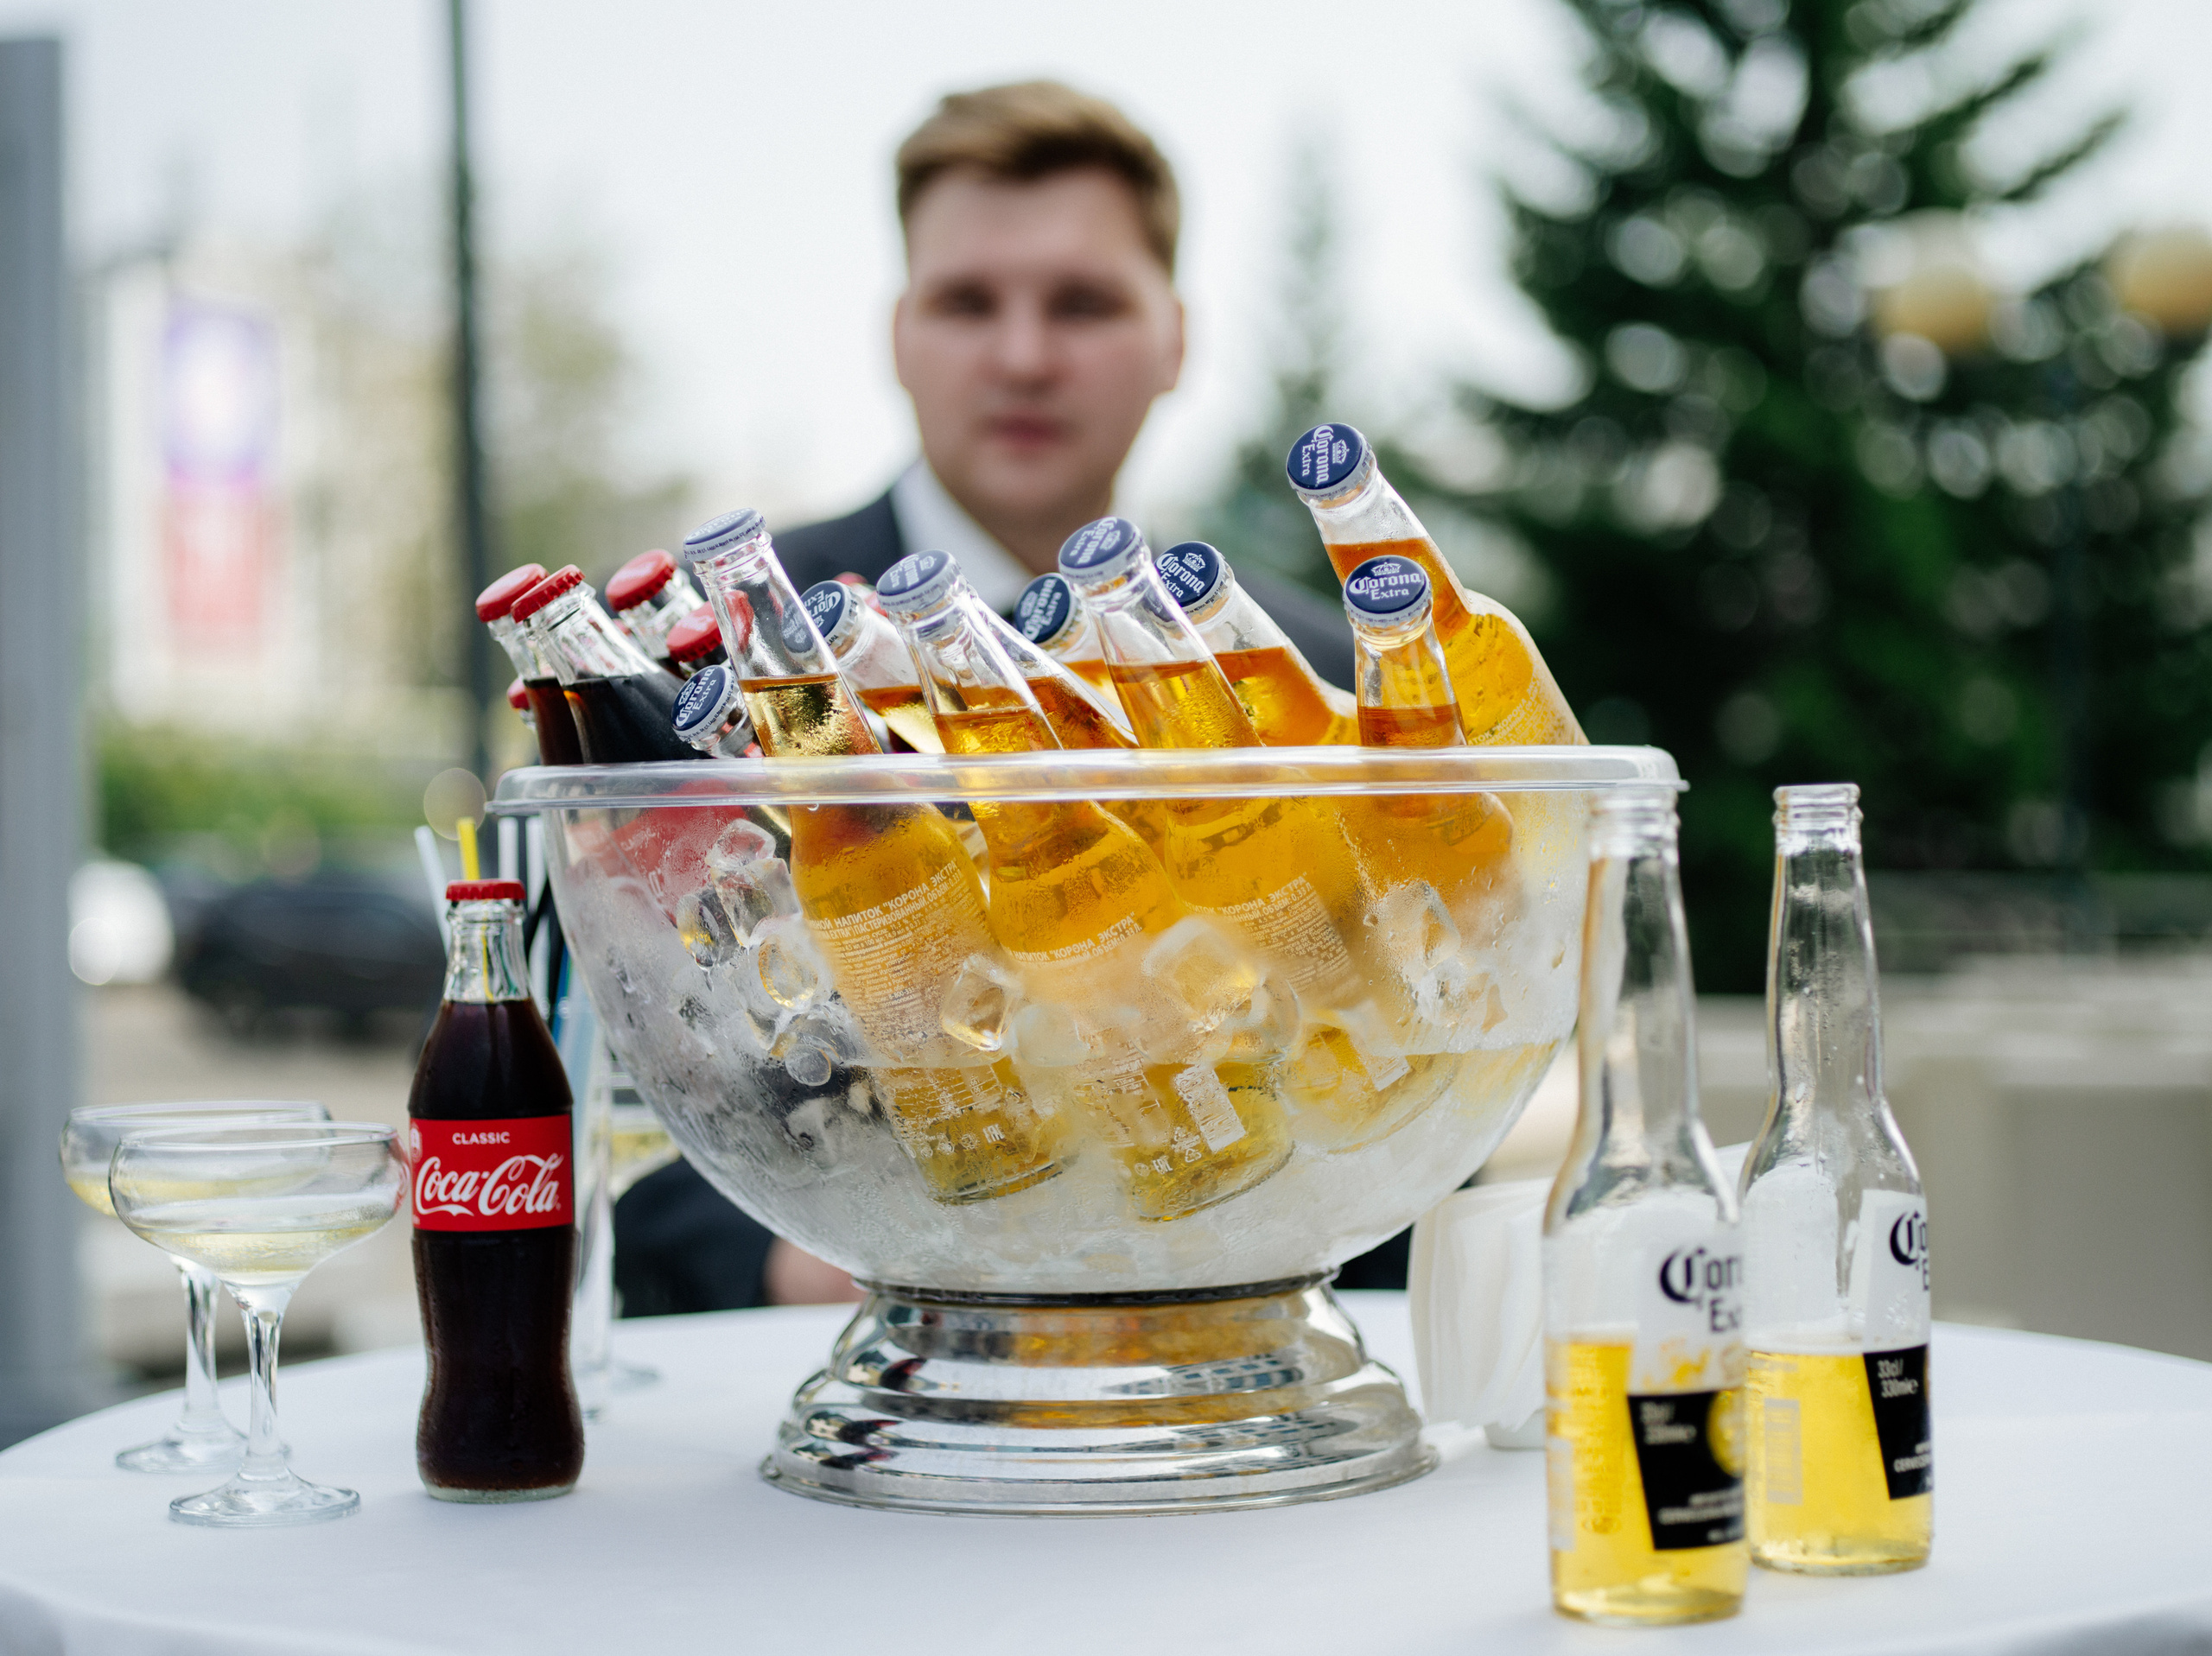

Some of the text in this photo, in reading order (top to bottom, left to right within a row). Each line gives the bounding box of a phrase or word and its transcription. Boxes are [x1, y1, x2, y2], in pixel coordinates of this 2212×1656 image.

[1301, 442, 1315, 477] Extra
[1311, 425, 1333, 484] Corona
[1070, 530, 1095, 556] Extra
[1077, 517, 1117, 565] Corona
[890, 566, 902, 587] Extra
[899, 554, 919, 587] Corona
[1156, 553, 1205, 593] Corona
[1161, 572, 1184, 598] Extra
[1349, 573, 1421, 594] Corona
[808, 591, 842, 617] Cor
[1022, 579, 1057, 641] Corona
[1039, 592, 1062, 625] Extra
[1370, 588, 1409, 600] Extra
[676, 669, 715, 726] Corona
[692, 679, 717, 710] Extra
[834, 904, 883, 929] НАПИТОК
[883, 882, 930, 911] "КОРОНА
[931, 858, 958, 887] ЭКСТРА"
[1217, 898, 1266, 916] "КОРОНА
[1268, 872, 1307, 903] ЭКСТРА"
[1262, 896, 1293, 916] ОБЪЕМ:
[1291, 888, 1307, 903] 0,33
[1013, 950, 1050, 962] НАПИТОК
[1049, 938, 1096, 960] "КОРОНА
[1097, 911, 1135, 943] ЭКСТРА"
[1299, 934, 1309, 943] del
[452, 1132, 511, 1145] CLASSIC
[415, 1152, 564, 1217] Coca-Cola
[1889, 1209, 1928, 1271] Co
[1657, 1244, 1744, 1310] Cor
